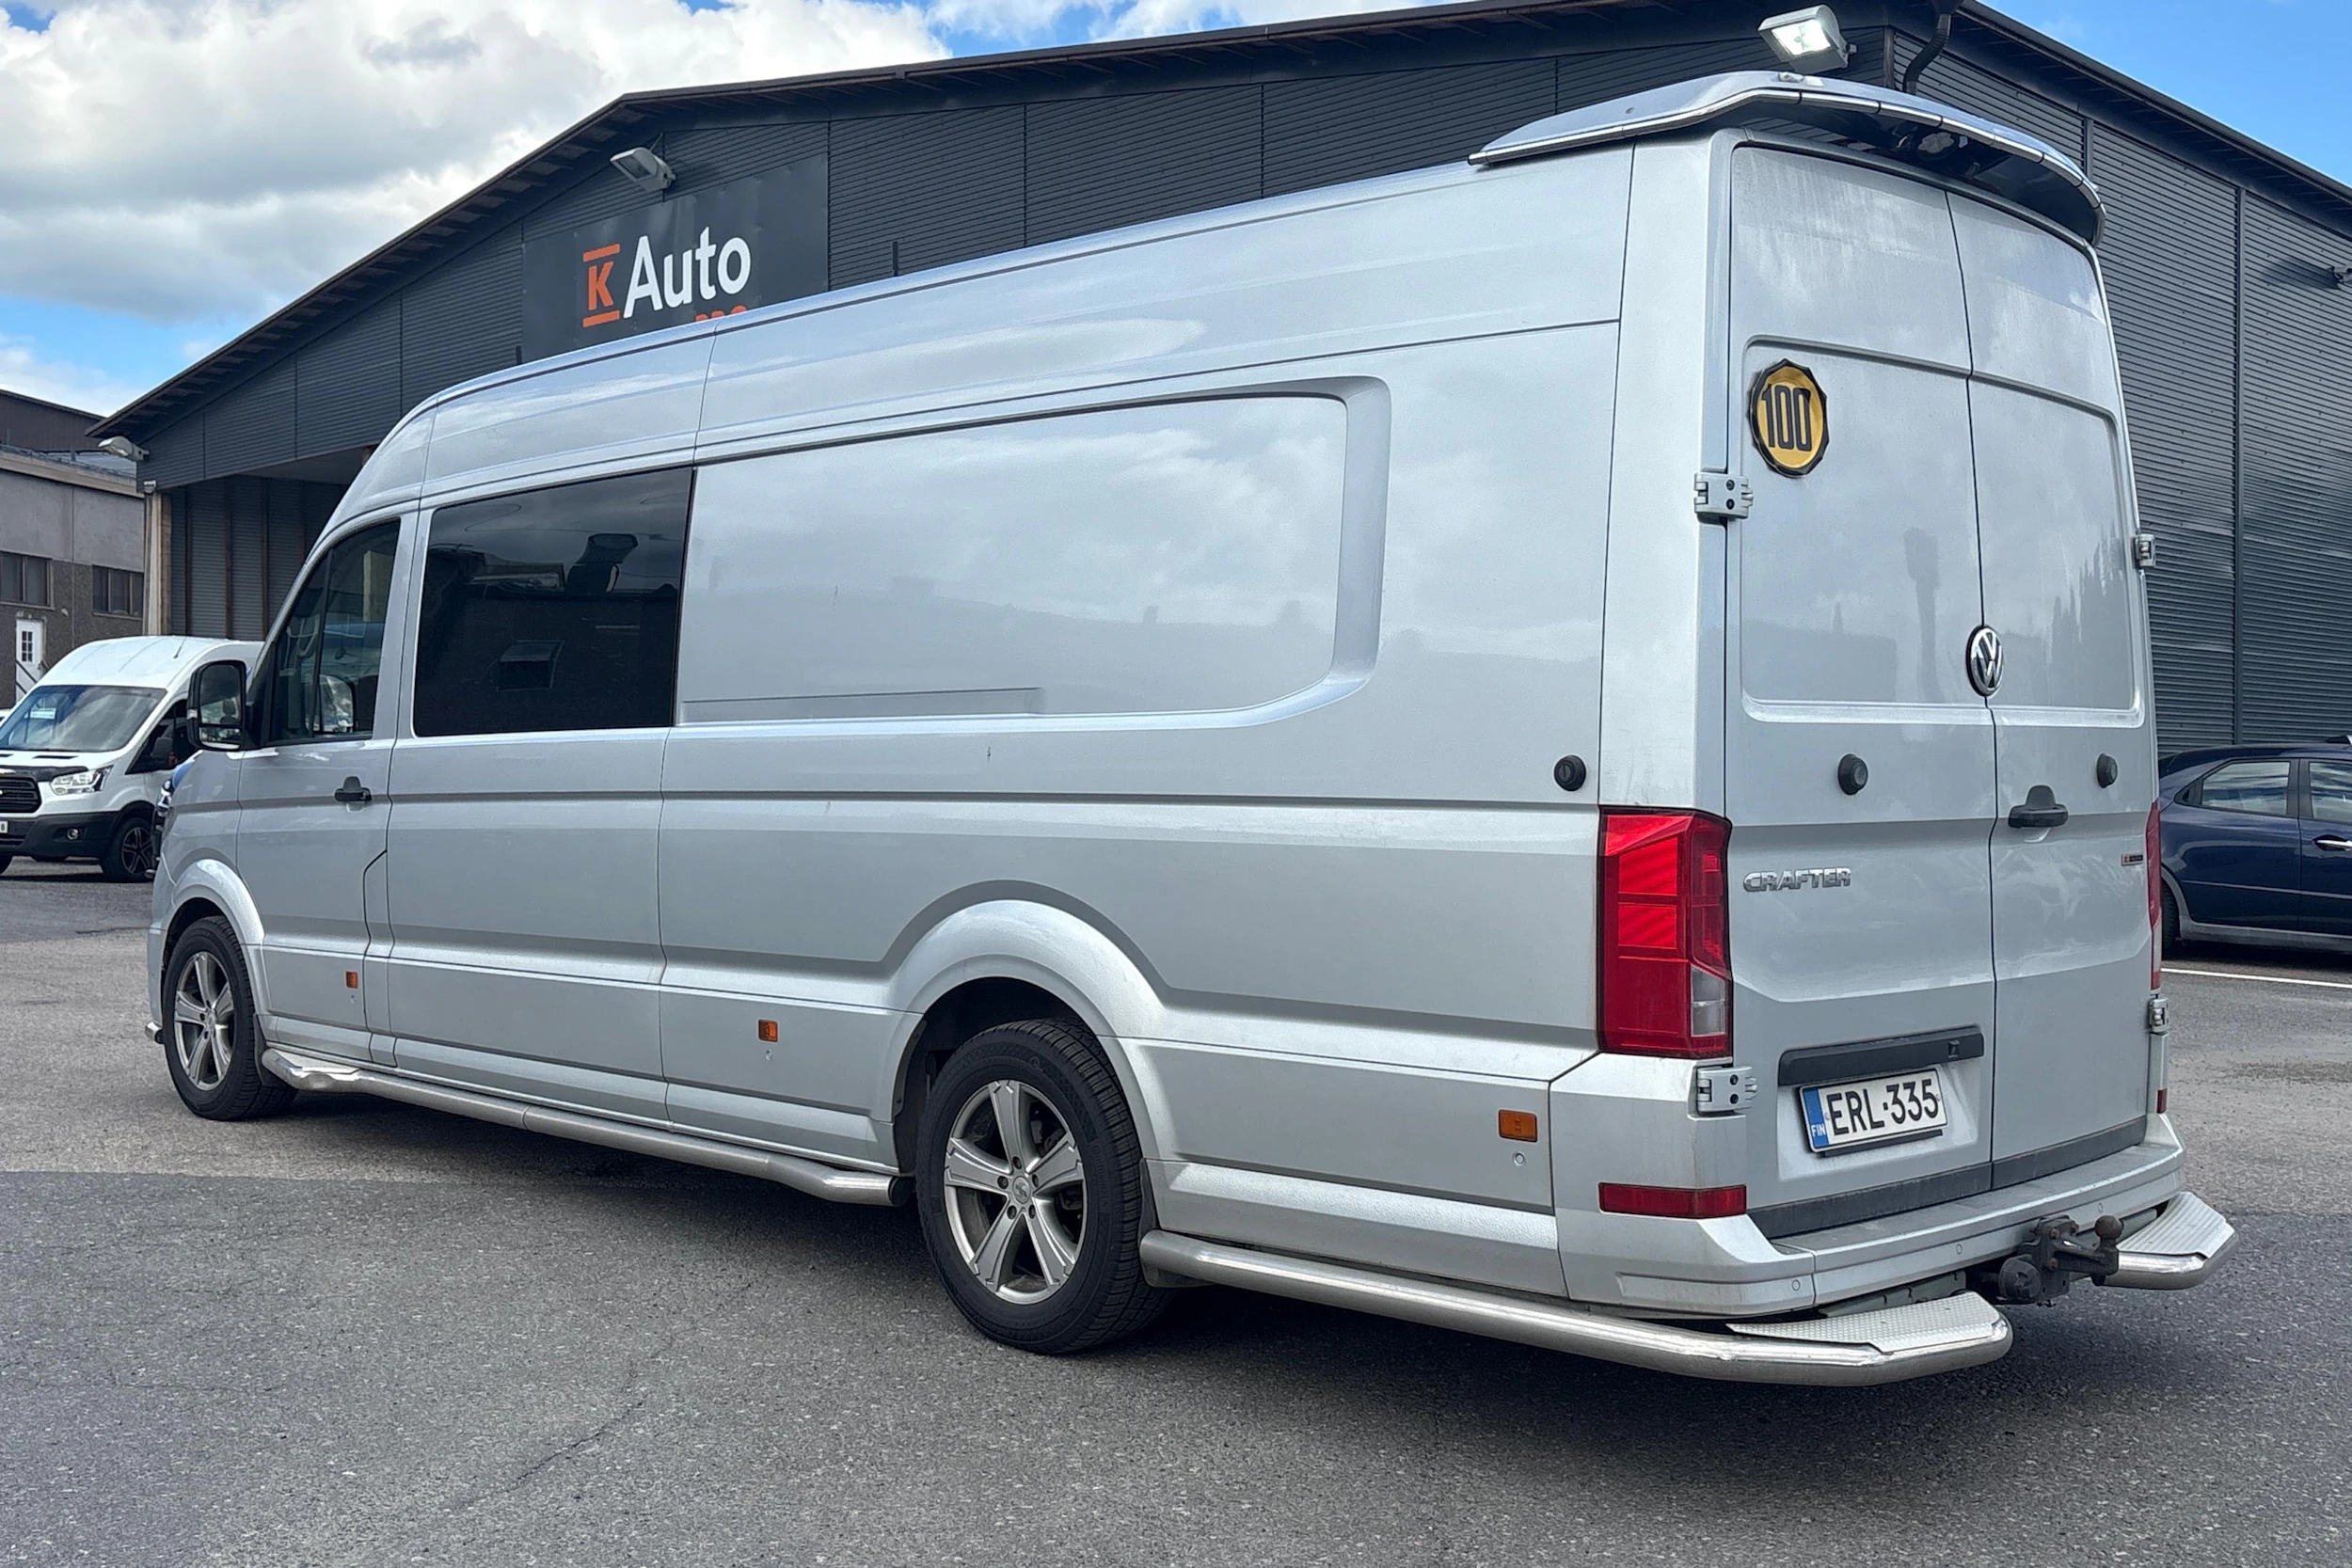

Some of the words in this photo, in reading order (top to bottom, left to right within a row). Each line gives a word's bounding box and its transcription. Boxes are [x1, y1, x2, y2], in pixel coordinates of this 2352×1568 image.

[623, 226, 752, 319] Auto
[1761, 384, 1813, 452] 100
[1742, 866, 1851, 893] CRAFTER
[1810, 1122, 1827, 1138] FIN
[1826, 1078, 1939, 1136] ERL-335
